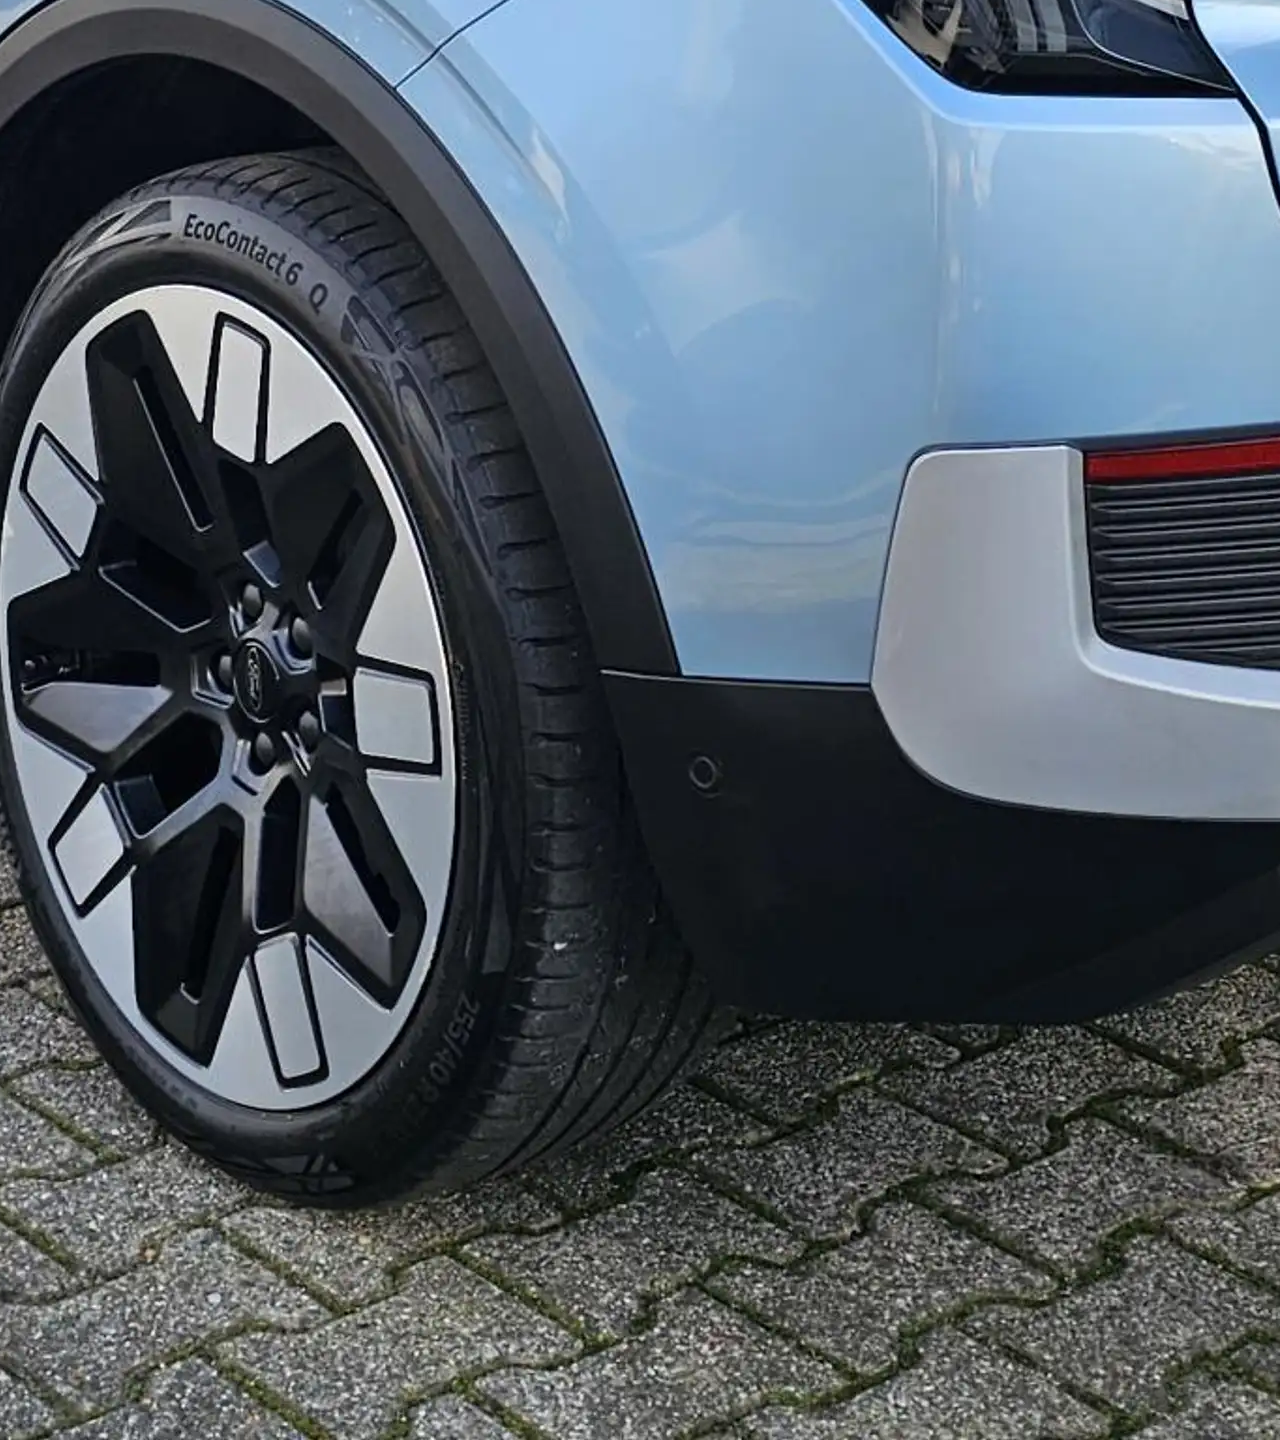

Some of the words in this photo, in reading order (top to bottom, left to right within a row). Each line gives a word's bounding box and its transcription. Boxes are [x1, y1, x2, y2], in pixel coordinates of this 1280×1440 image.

[183, 213, 287, 278] EcoContact
[284, 262, 304, 286] 6
[308, 282, 329, 315] Q
[429, 990, 481, 1086] 255/40
